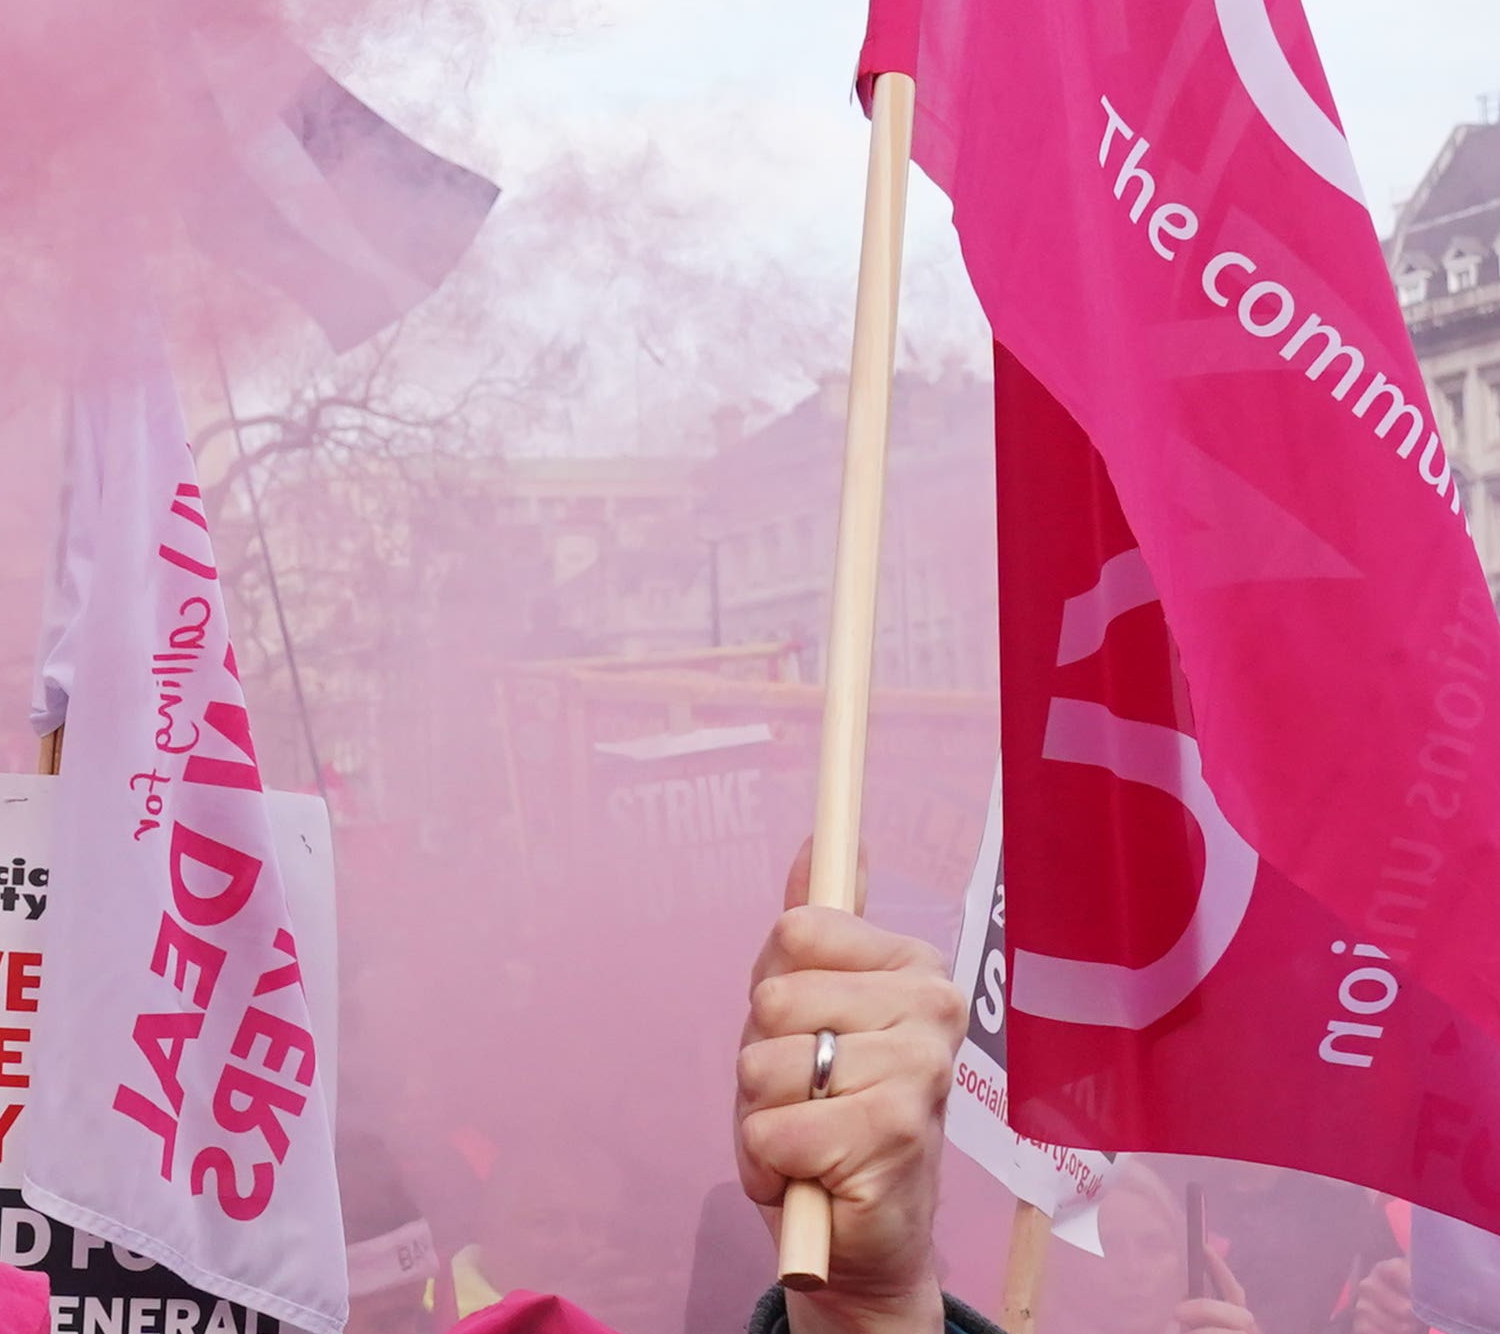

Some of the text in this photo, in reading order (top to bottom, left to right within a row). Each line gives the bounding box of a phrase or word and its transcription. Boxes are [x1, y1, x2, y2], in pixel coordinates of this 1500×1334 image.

[1097, 94, 1199, 261] The
[1202, 249, 1472, 538] commu
[606, 768, 766, 846] STRIKE
[72, 1223, 156, 1269] FO
